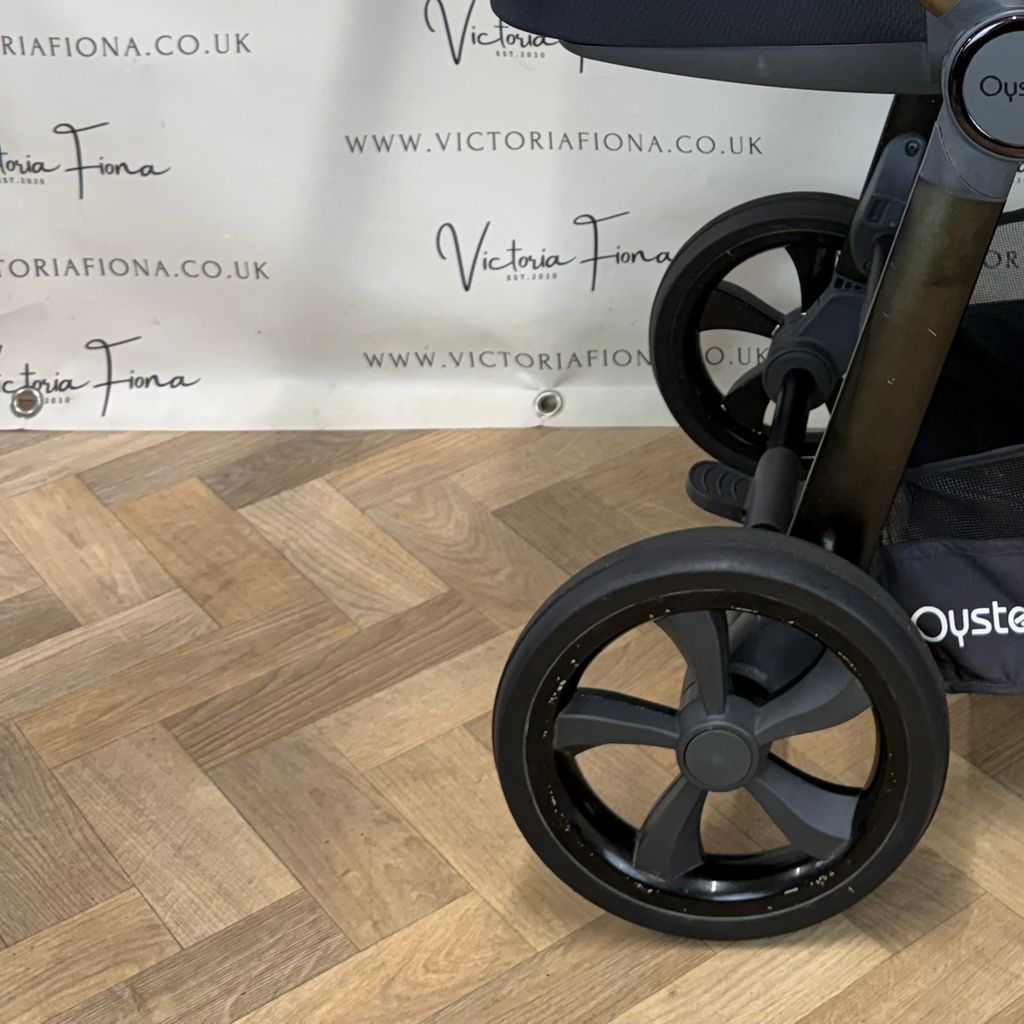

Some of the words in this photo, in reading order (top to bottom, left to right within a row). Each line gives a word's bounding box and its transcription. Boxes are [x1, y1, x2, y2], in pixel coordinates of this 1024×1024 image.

[53, 122, 172, 199] Fiona
[345, 131, 763, 155] WWW.VICTORIAFIONA.CO.UK
[436, 221, 577, 292] Victoria
[573, 211, 673, 292] Fiona
[85, 336, 201, 416] Fiona
